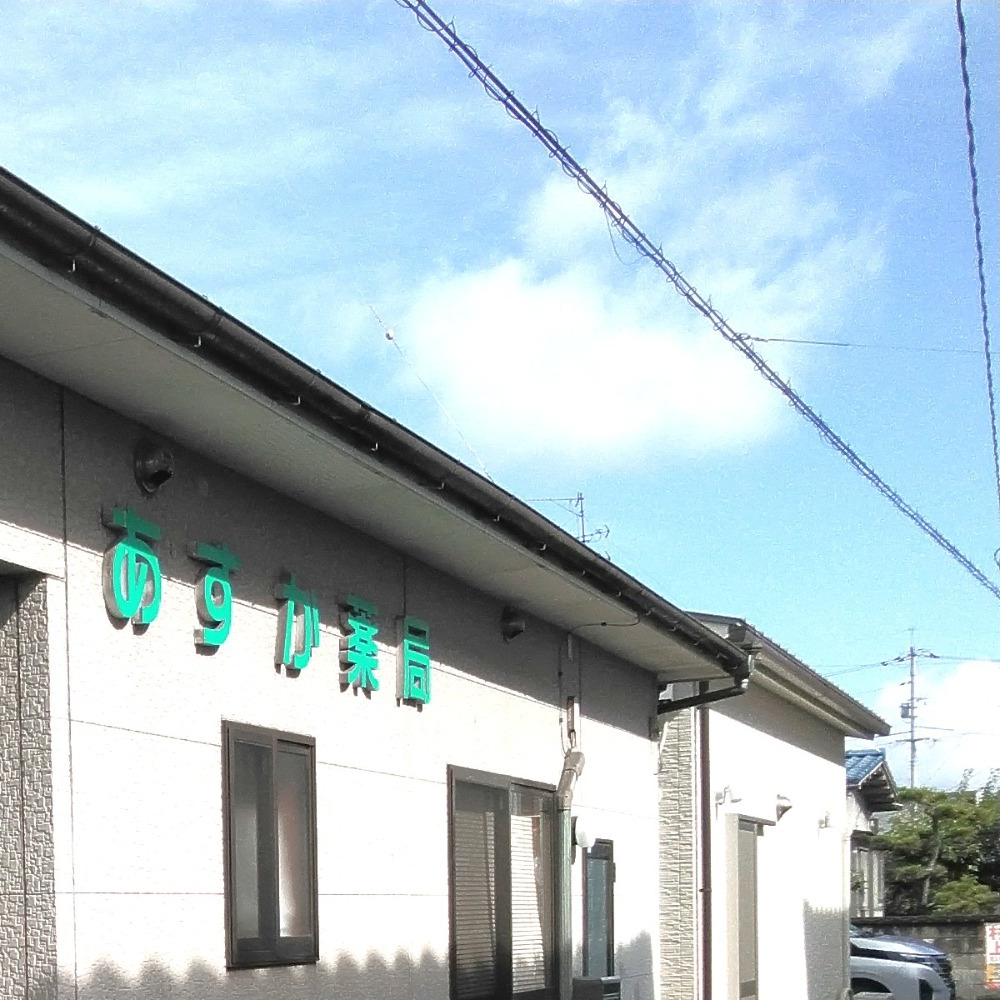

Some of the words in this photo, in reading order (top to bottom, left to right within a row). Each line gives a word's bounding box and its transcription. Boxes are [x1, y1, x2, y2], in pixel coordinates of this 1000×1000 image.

[112, 507, 431, 704] あすか薬局
